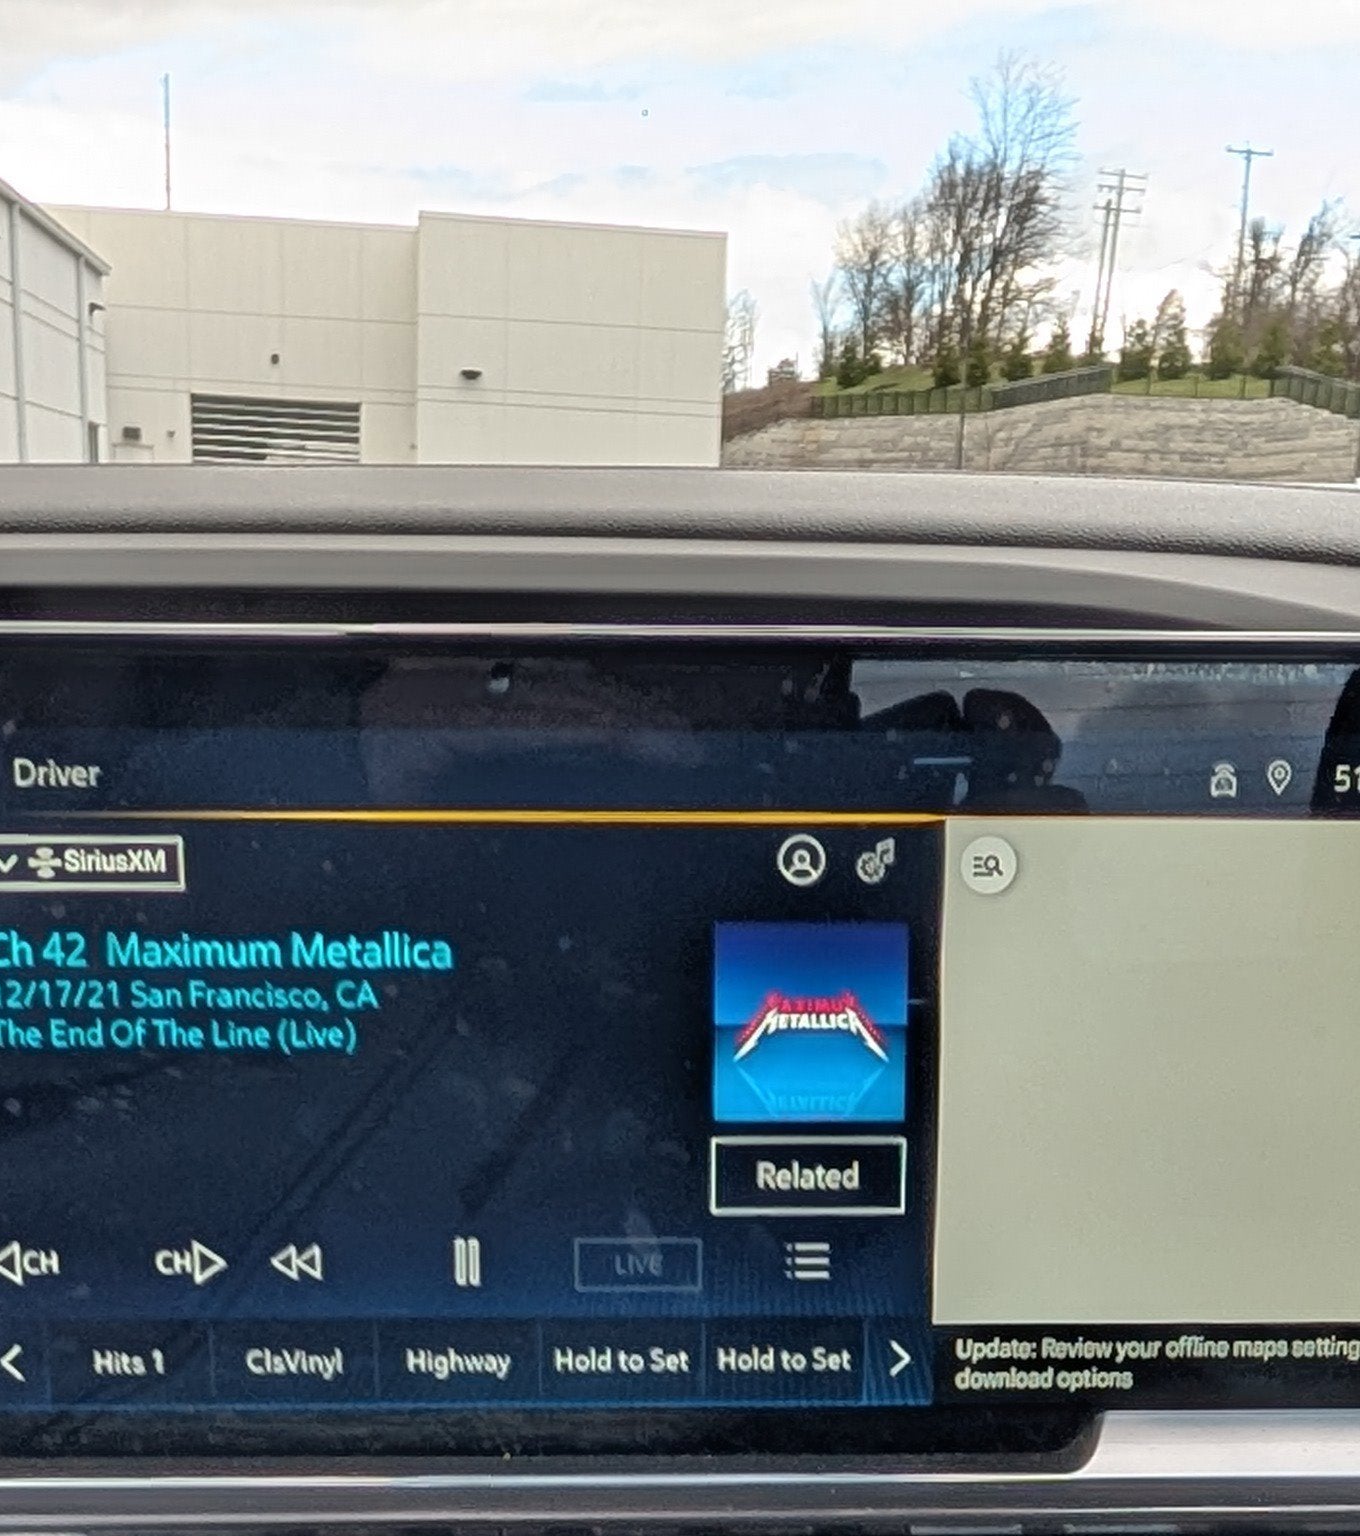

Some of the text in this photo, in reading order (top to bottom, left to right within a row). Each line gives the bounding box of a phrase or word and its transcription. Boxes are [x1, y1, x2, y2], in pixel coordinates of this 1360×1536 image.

[13, 759, 101, 788] Driver
[65, 848, 166, 875] SiriusXM
[42, 932, 86, 969] 42
[107, 932, 282, 969] Maximum
[293, 932, 452, 970] Metallica
[131, 981, 182, 1010] San
[189, 980, 328, 1014] Francisco,
[335, 981, 379, 1010] CA
[51, 1019, 103, 1049] End
[111, 1019, 147, 1049] Of
[152, 1019, 203, 1049] The
[211, 1019, 270, 1049] Line
[279, 1019, 357, 1054] (Live)
[733, 1007, 889, 1063] METALLICA
[756, 1160, 860, 1191] Related
[22, 1250, 59, 1277] CH
[155, 1250, 192, 1277] CH
[615, 1254, 663, 1276] LIVE
[93, 1348, 165, 1376] Hits 1
[405, 1345, 511, 1379] Highway
[555, 1345, 688, 1375] Hold to Set
[717, 1345, 851, 1375] Hold to Set
[955, 1337, 1036, 1361] Update:
[1042, 1337, 1112, 1359] Review
[1115, 1340, 1162, 1363] your
[1166, 1336, 1229, 1358] offline
[1232, 1340, 1288, 1362] maps
[955, 1367, 1133, 1391] download options
